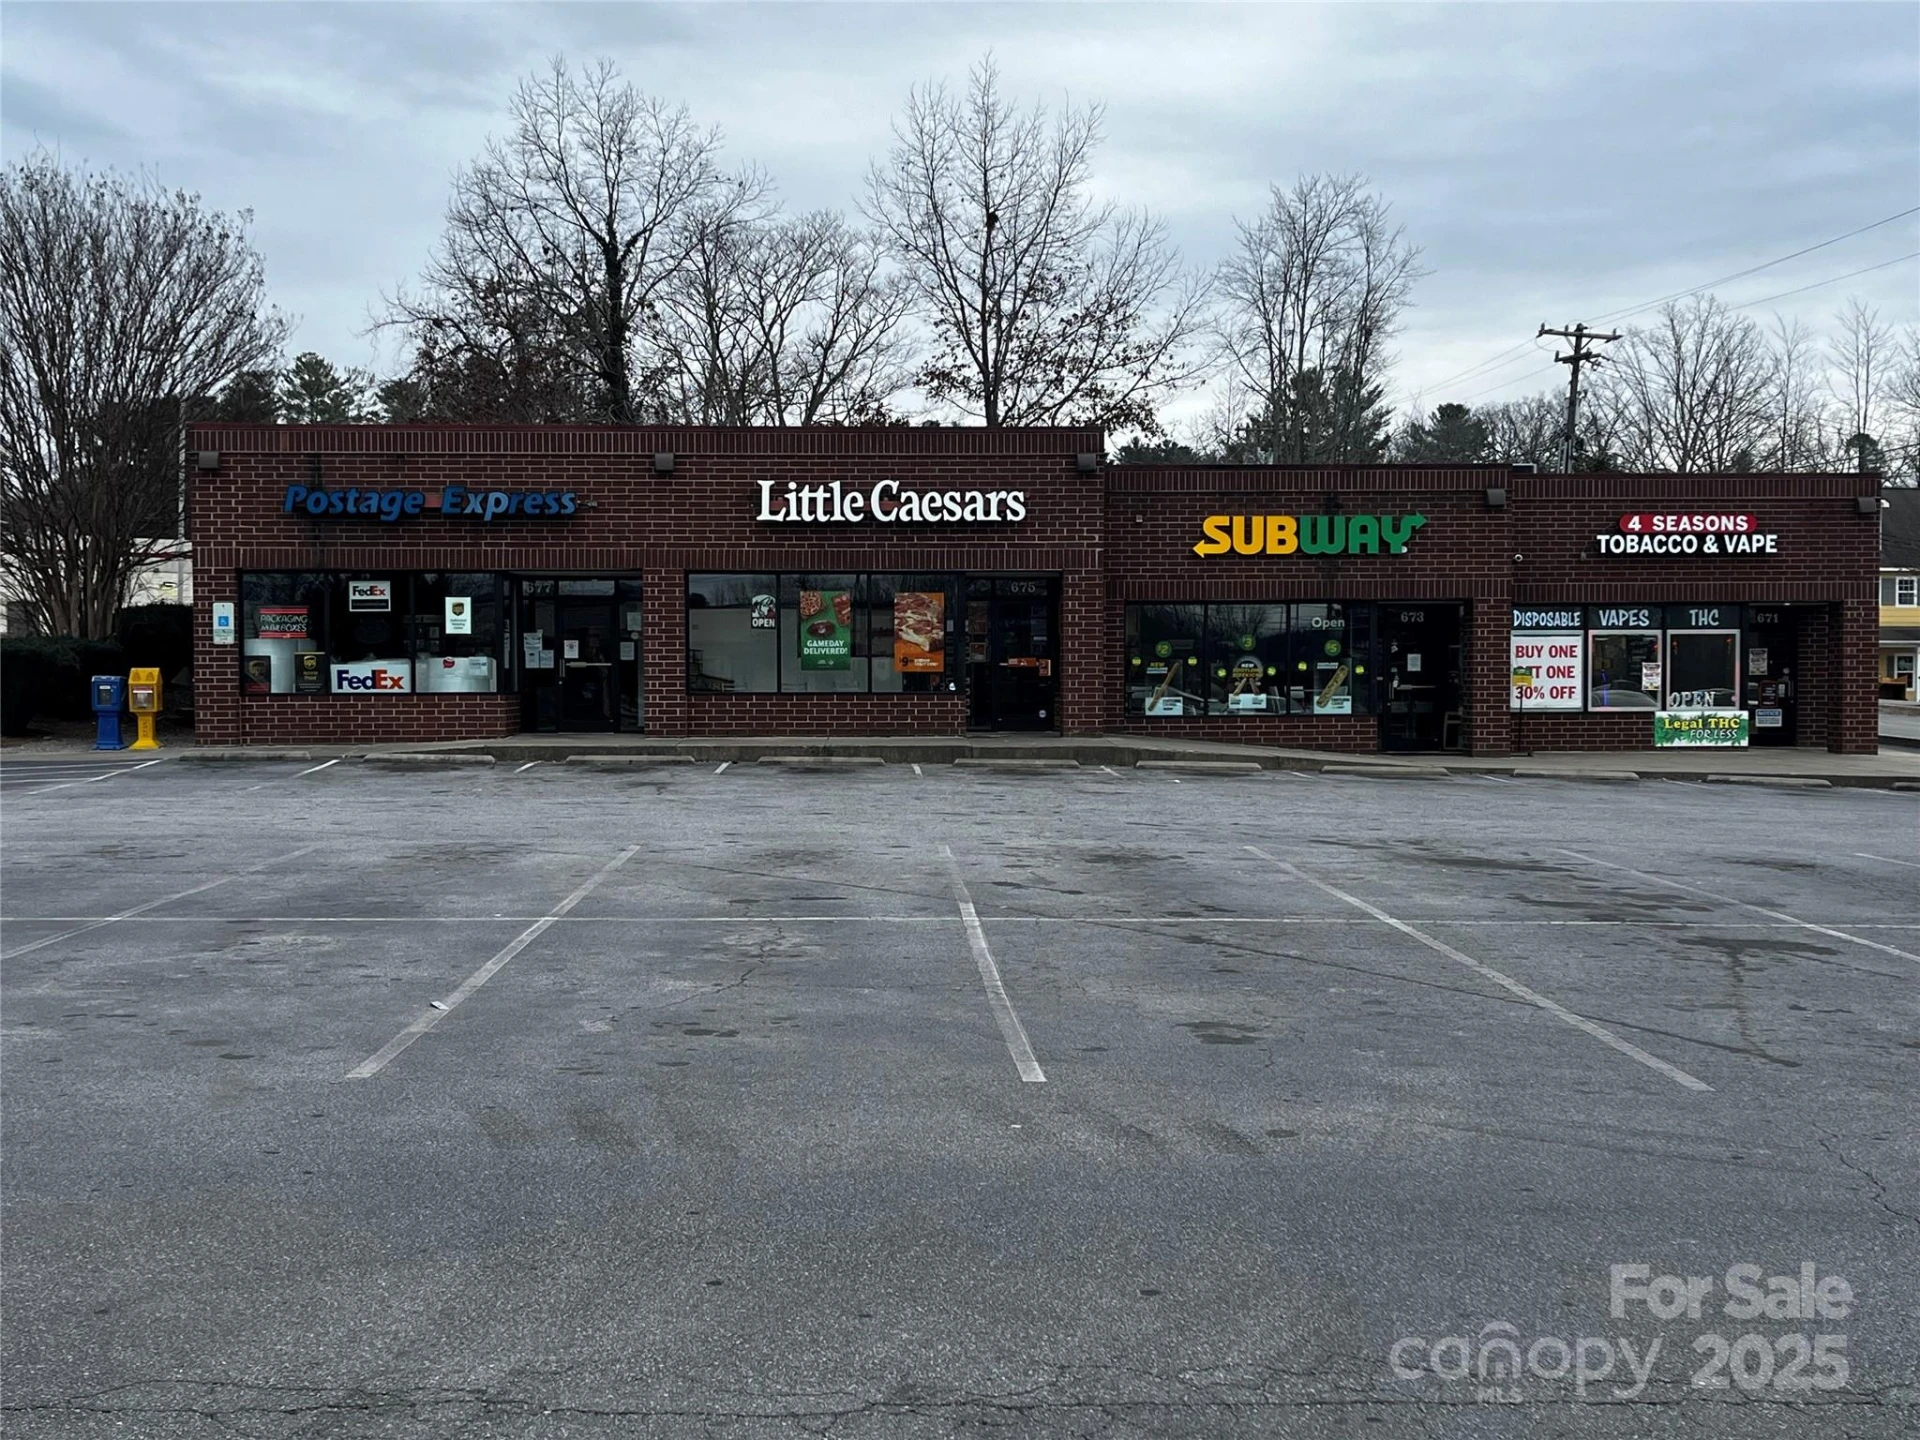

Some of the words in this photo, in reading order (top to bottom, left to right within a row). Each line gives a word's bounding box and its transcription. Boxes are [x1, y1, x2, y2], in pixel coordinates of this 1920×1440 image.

[284, 485, 425, 521] Postage
[441, 486, 577, 521] Express
[756, 480, 863, 522] Little
[870, 479, 1026, 522] Caesars
[1628, 517, 1642, 531] 4
[1652, 516, 1748, 532] SEASONS
[1193, 511, 1427, 558] SUBWAY
[1597, 535, 1698, 554] TOBACCO
[1703, 535, 1719, 554] &
[1724, 535, 1777, 553] VAPE
[352, 585, 386, 596] FedEx
[527, 583, 552, 593] 677
[1011, 582, 1036, 593] 675
[260, 615, 308, 623] PACKAGING
[752, 618, 775, 627] OPEN
[1311, 617, 1345, 630] Open
[1400, 612, 1424, 622] 673
[1513, 610, 1581, 627] DISPOSABLE
[1600, 609, 1650, 626] VAPES
[1689, 609, 1719, 626] THC
[1757, 613, 1778, 623] 671
[803, 647, 848, 655] DELIVERED!
[1515, 645, 1544, 658] BUY
[1549, 645, 1578, 658] ONE
[1546, 666, 1575, 678] ONE
[336, 669, 404, 690] FedEx
[1515, 686, 1545, 699] 30%
[1549, 686, 1577, 699] OFF
[1669, 691, 1716, 708] OPEN
[1663, 718, 1703, 731] Legal
[1707, 718, 1740, 729] THC
[1690, 729, 1711, 739] FOR
[1713, 729, 1738, 739] LESS
